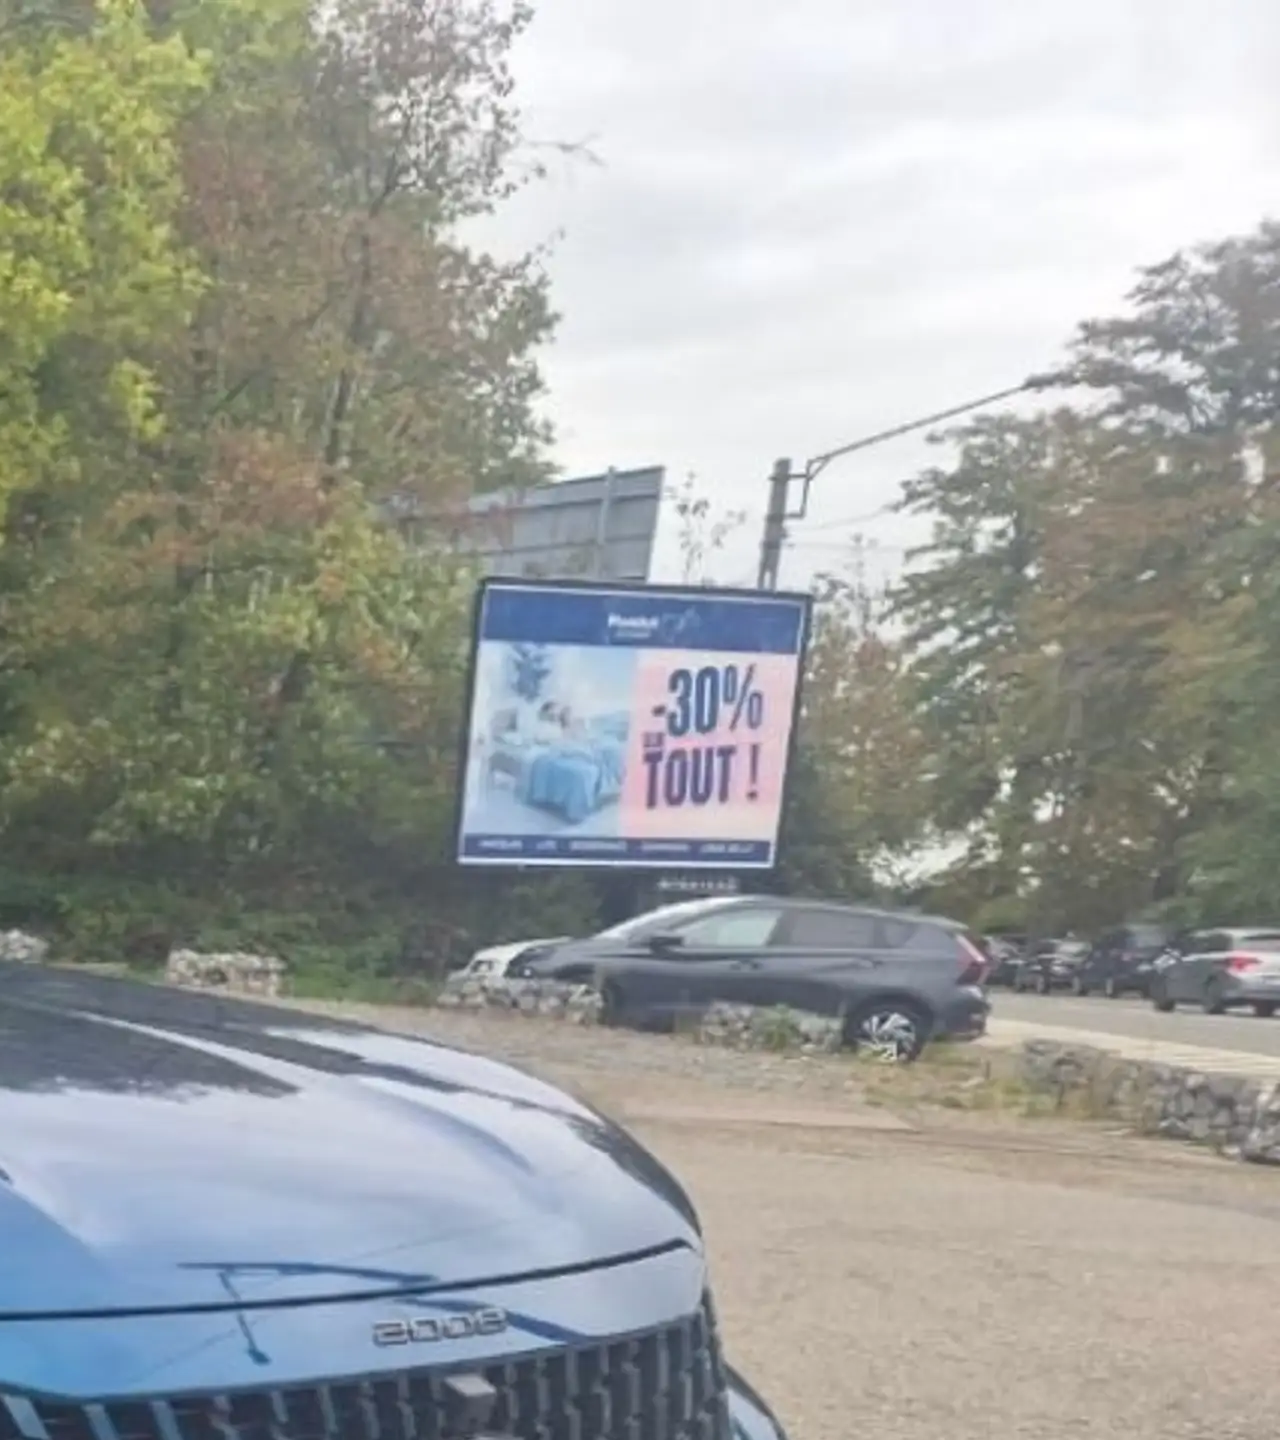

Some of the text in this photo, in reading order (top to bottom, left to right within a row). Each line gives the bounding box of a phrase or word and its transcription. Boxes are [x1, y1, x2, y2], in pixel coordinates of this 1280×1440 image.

[652, 663, 763, 737] -30%
[643, 742, 762, 811] TOUT !
